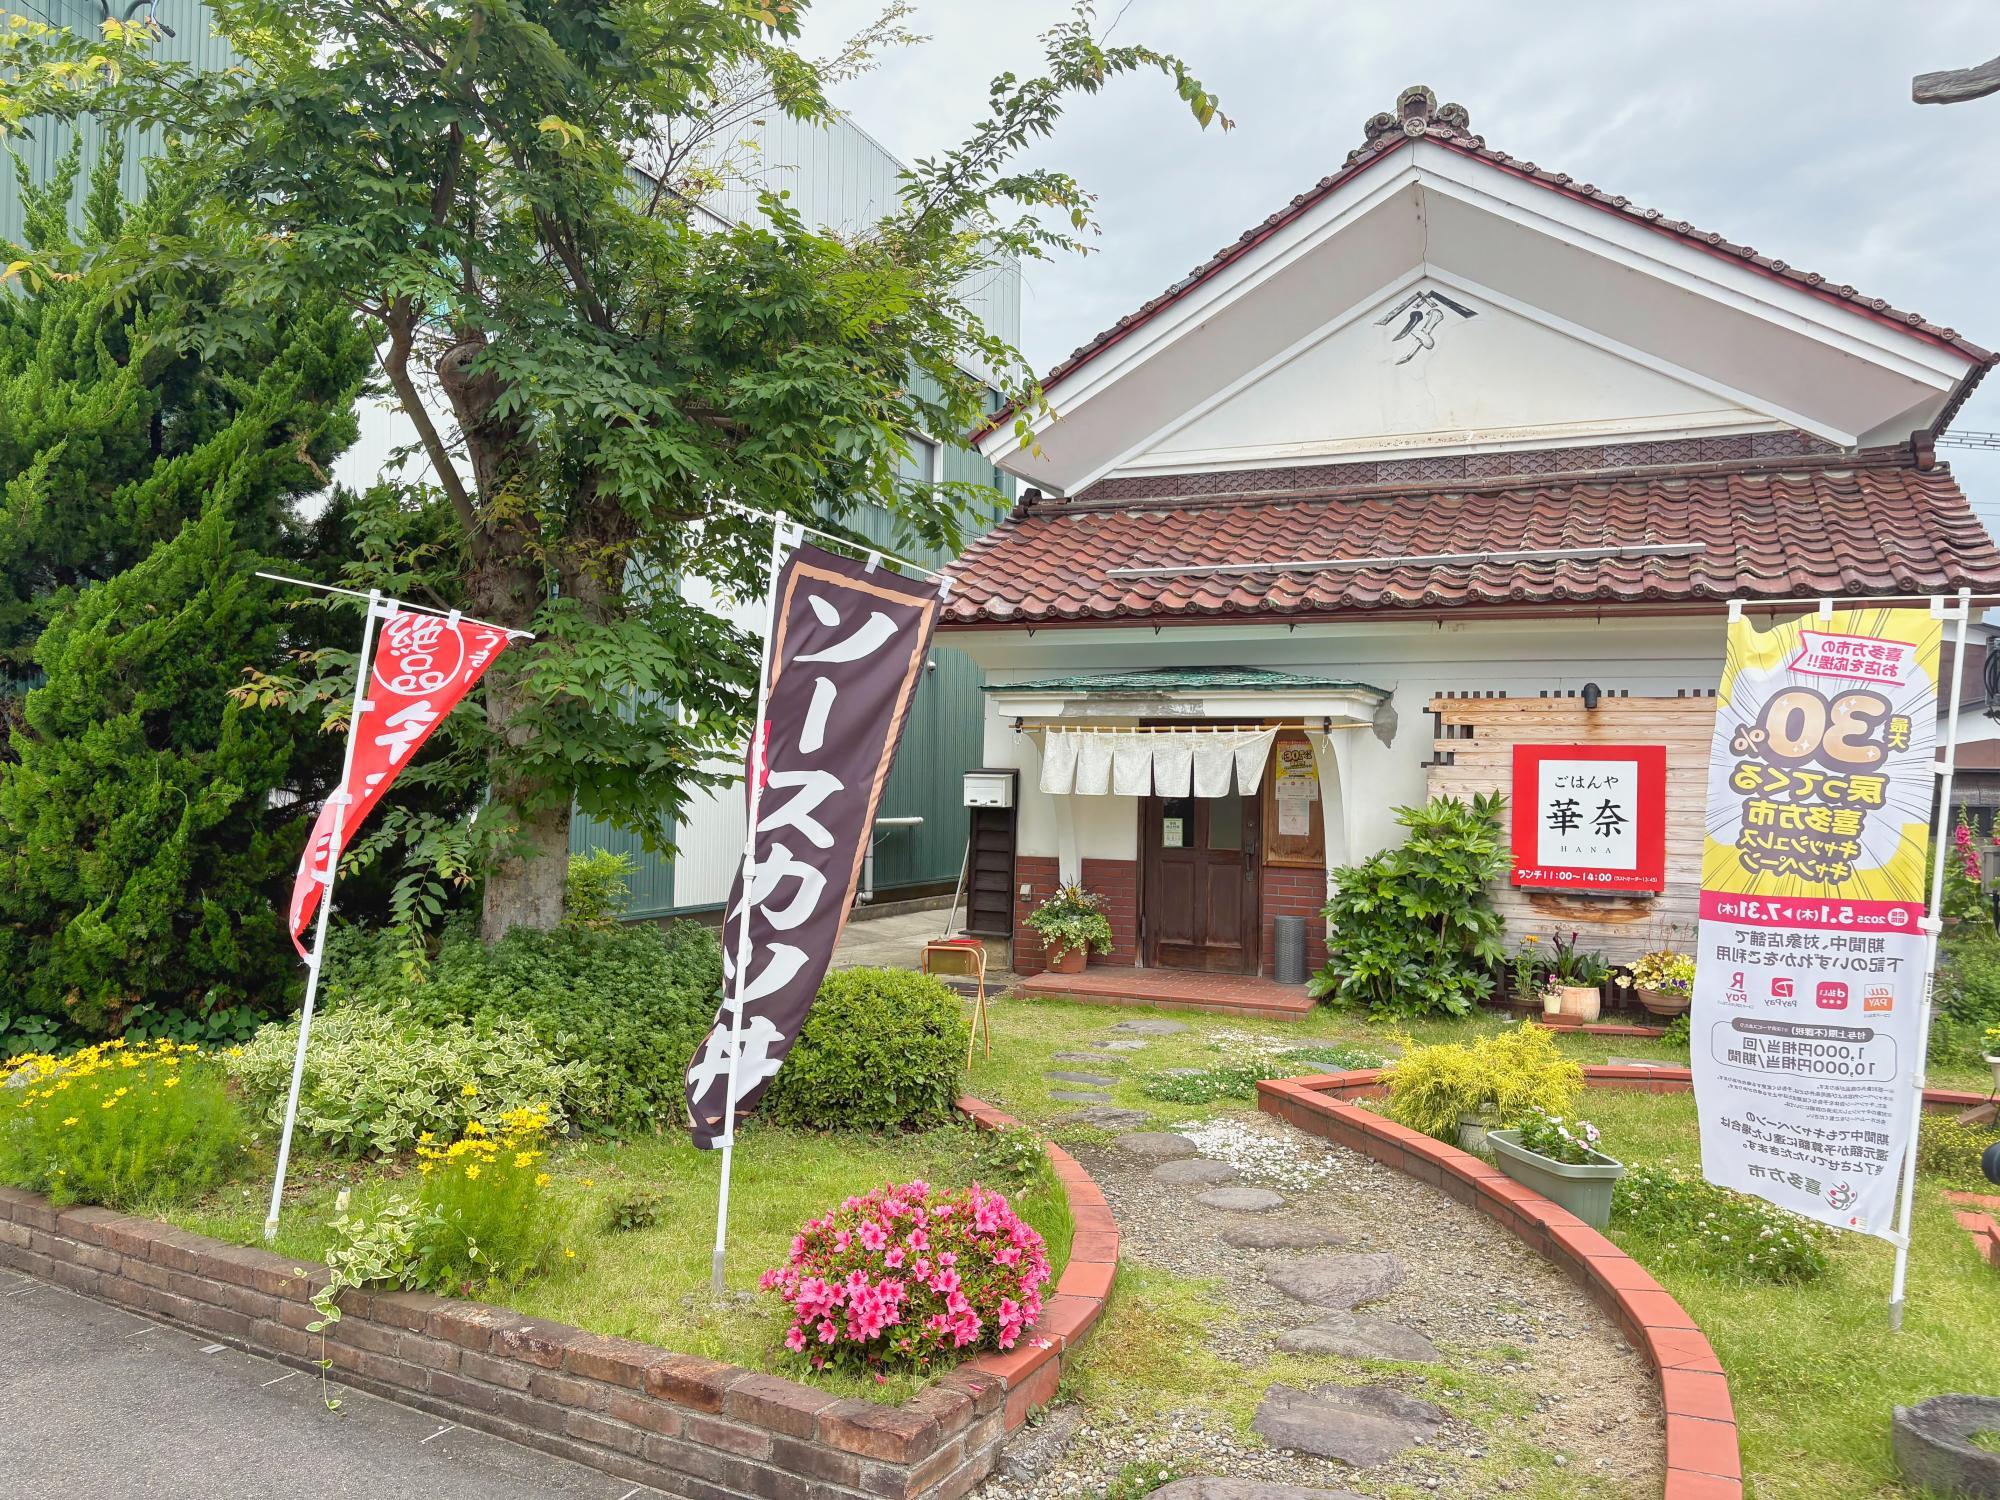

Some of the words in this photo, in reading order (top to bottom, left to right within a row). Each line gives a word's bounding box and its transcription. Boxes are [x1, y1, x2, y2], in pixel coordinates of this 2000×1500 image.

[1555, 776, 1619, 789] ごはんや
[1546, 798, 1629, 838] 華奈
[689, 594, 898, 1105] ソースカツ丼
[1561, 846, 1611, 854] HANA
